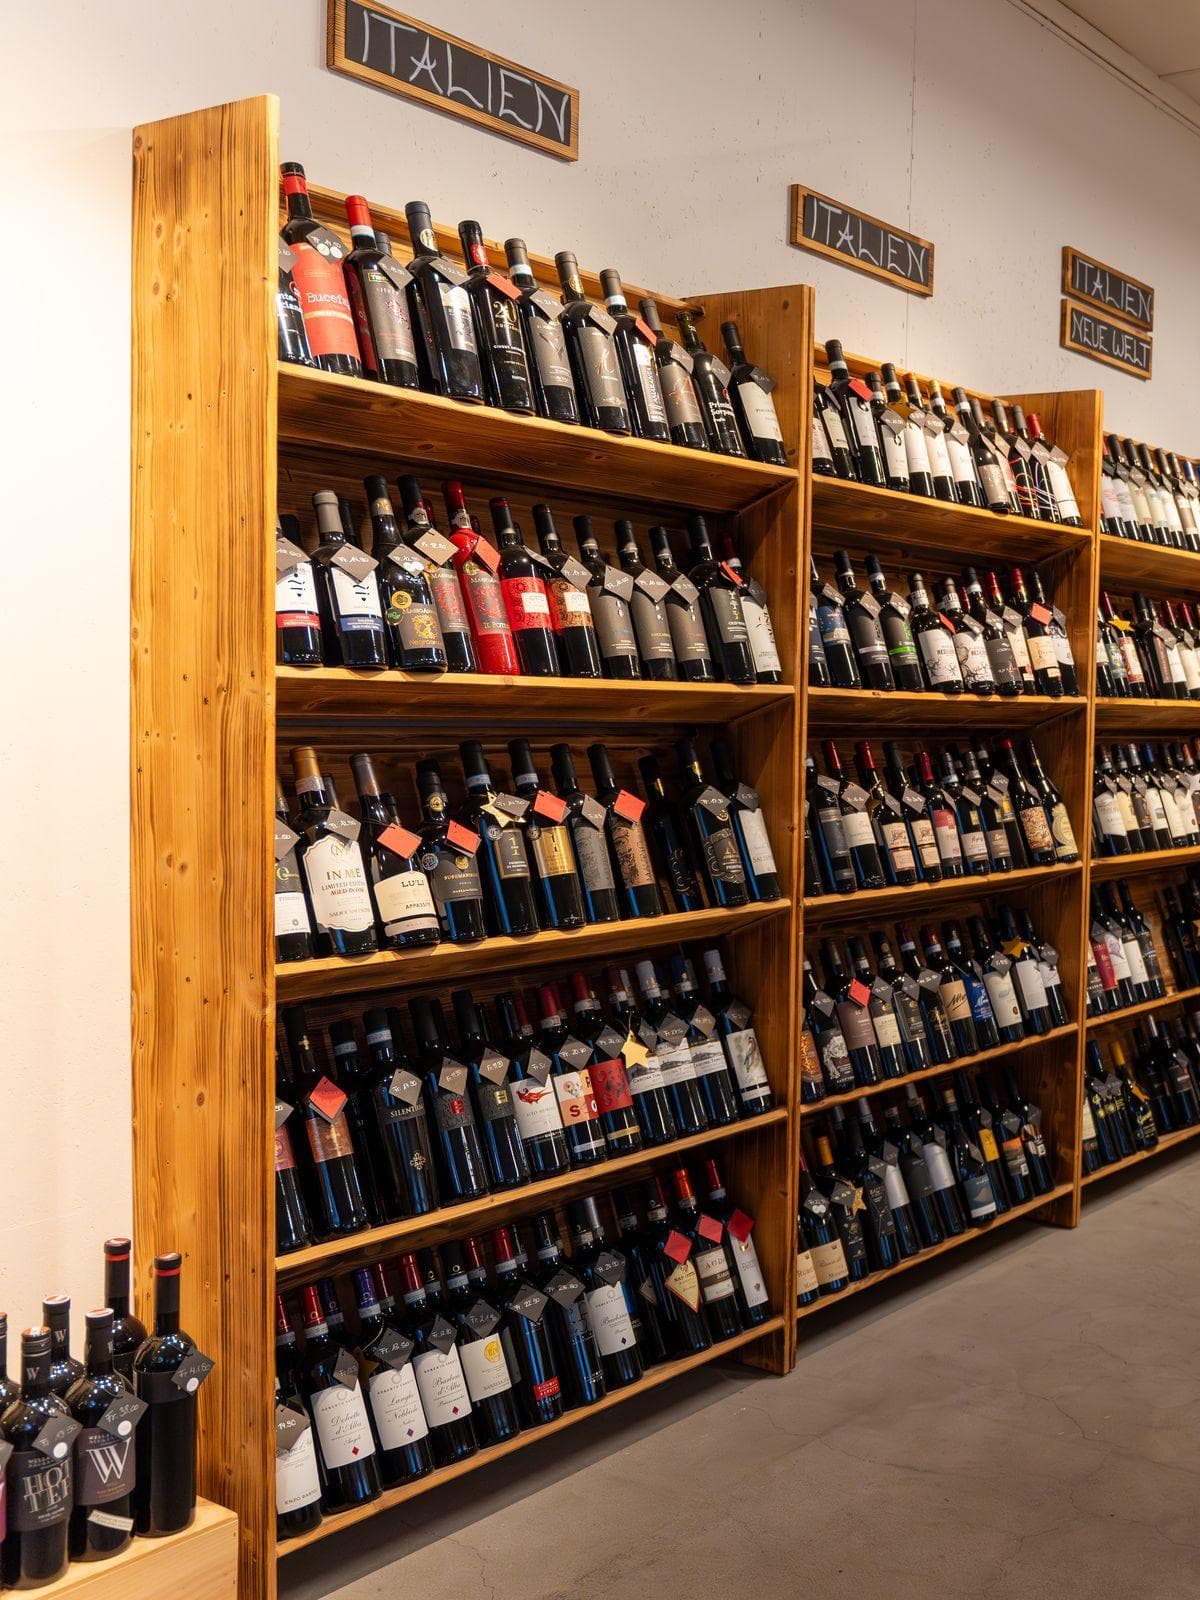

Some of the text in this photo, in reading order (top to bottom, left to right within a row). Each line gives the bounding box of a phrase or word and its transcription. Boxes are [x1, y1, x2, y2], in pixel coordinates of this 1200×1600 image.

[363, 9, 570, 143] ITALIEN
[811, 197, 926, 283] ITALIEN
[1075, 257, 1152, 323] ITALIEN
[1072, 311, 1151, 369] NEUE WELT
[326, 870, 342, 881] IN
[54, 1329, 66, 1343] W
[26, 1367, 40, 1381] W
[86, 1436, 132, 1484] W
